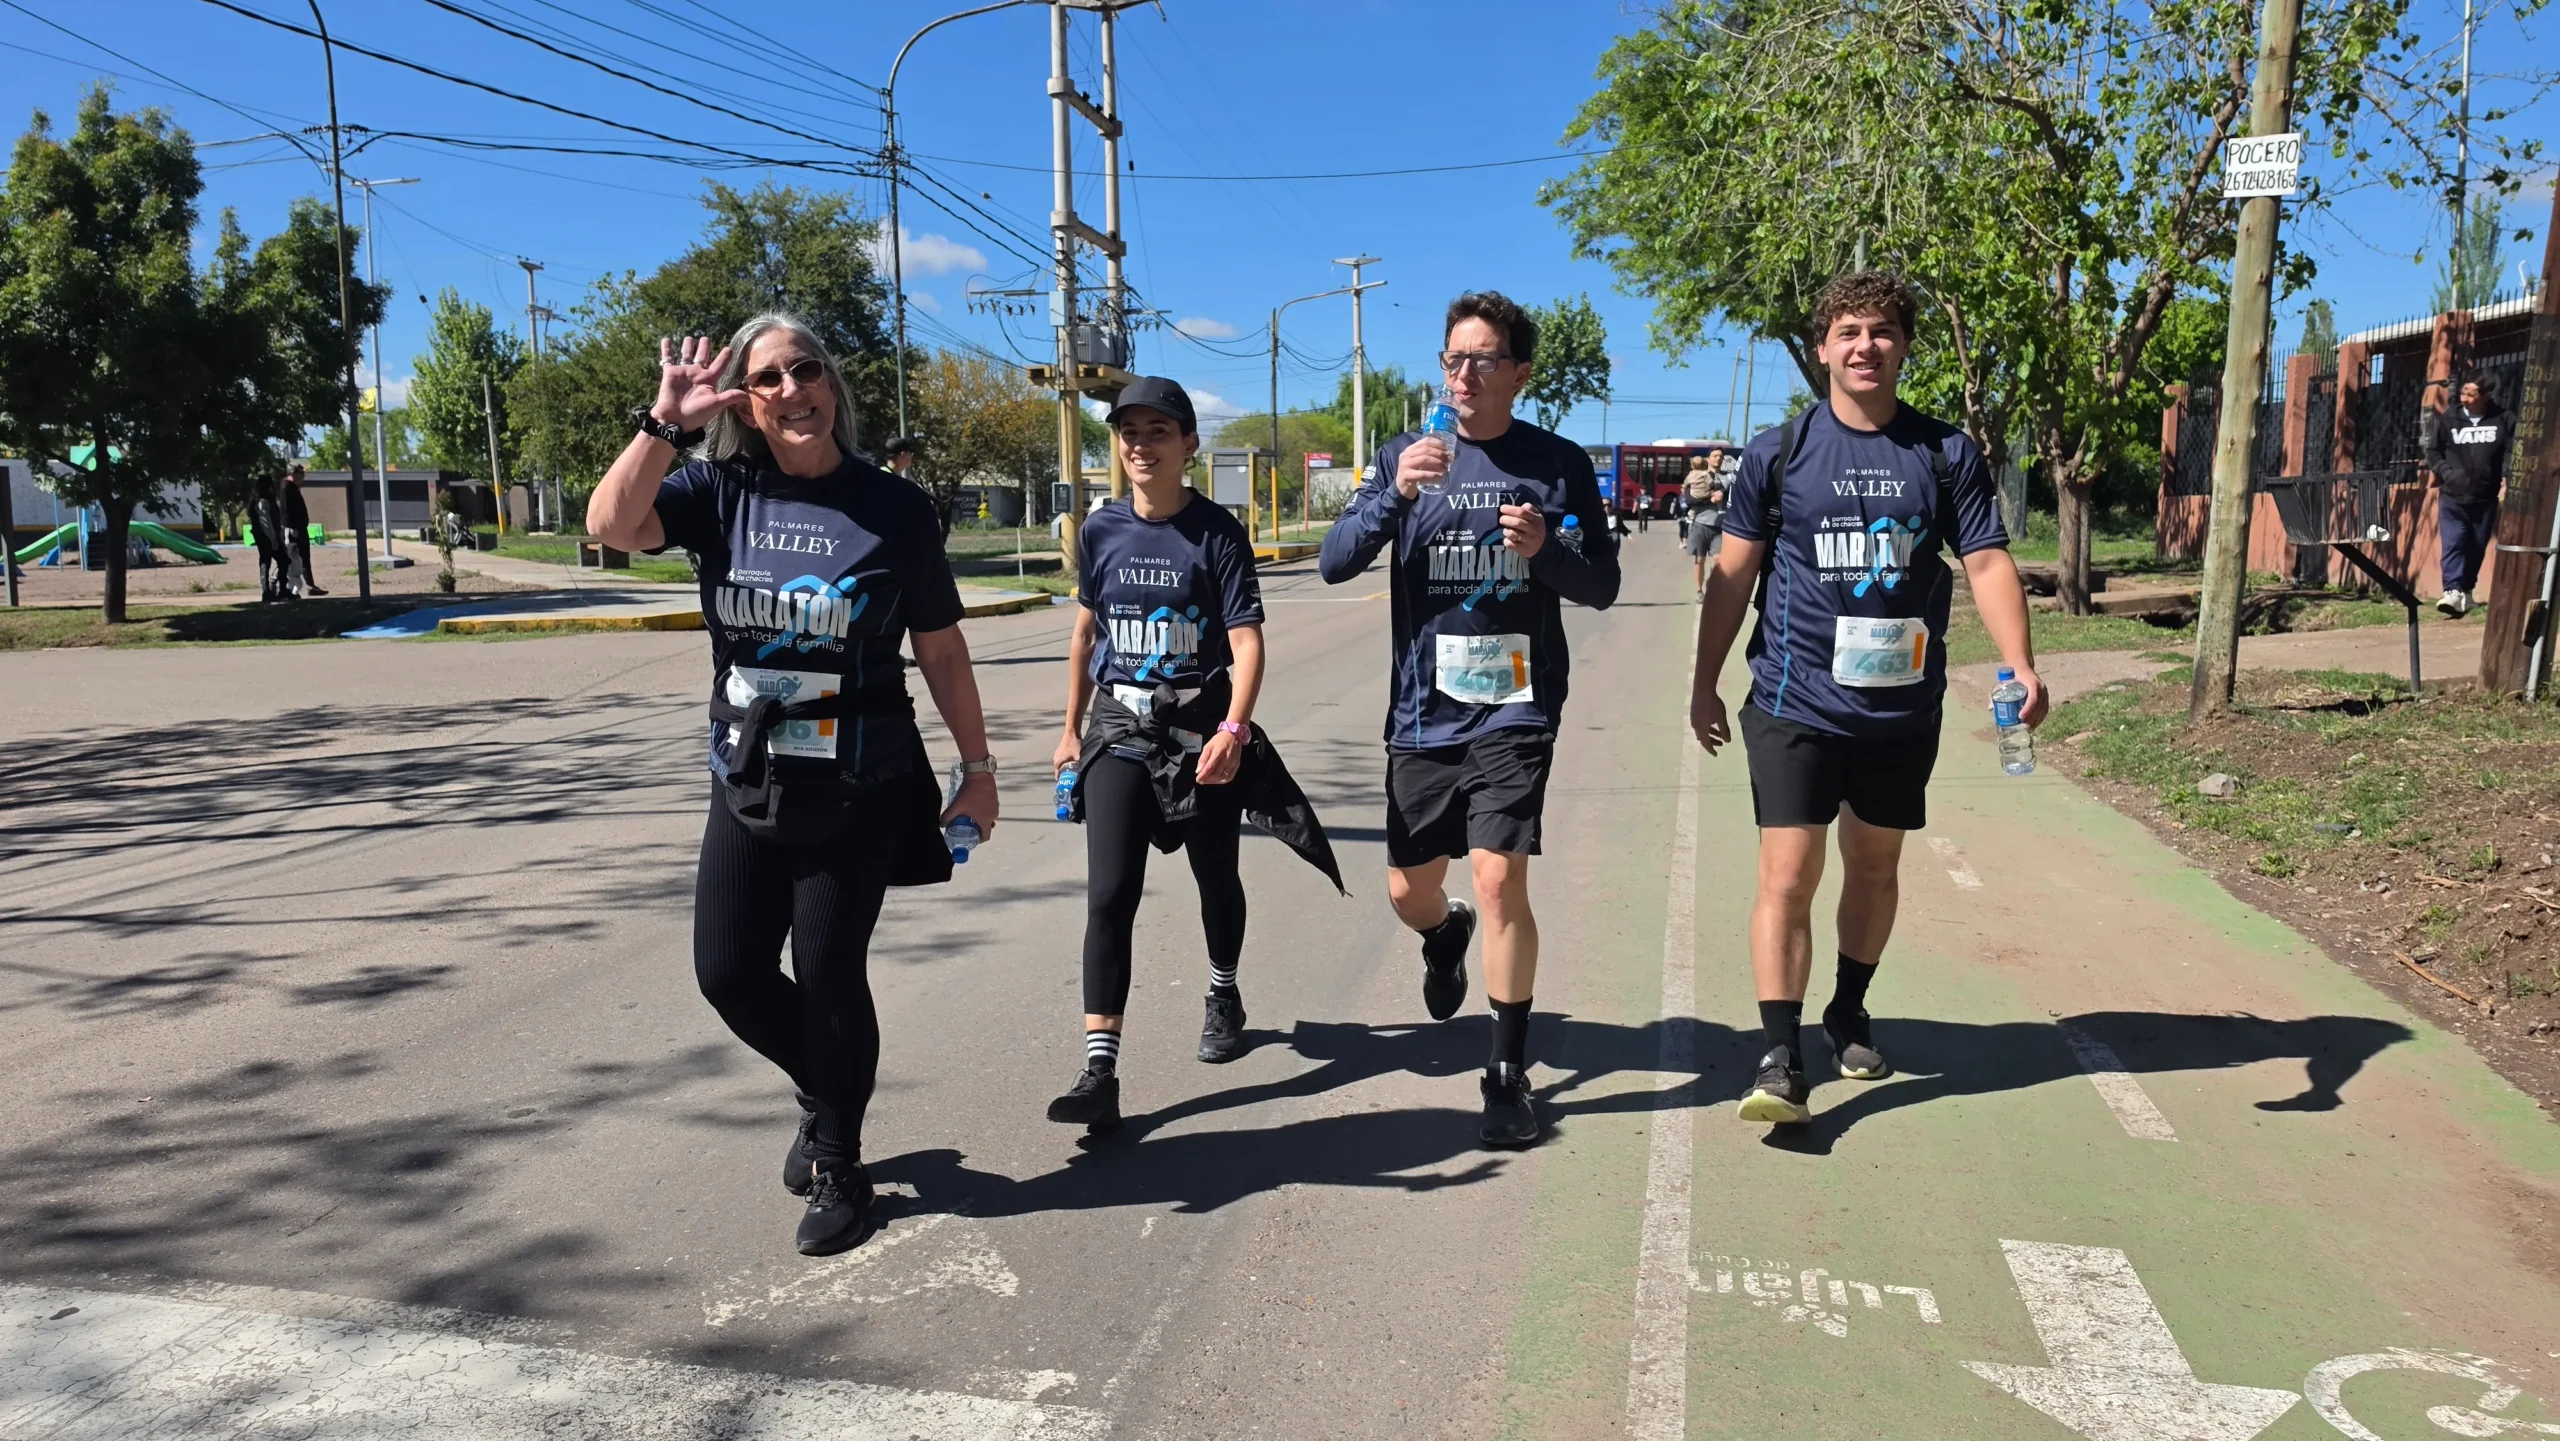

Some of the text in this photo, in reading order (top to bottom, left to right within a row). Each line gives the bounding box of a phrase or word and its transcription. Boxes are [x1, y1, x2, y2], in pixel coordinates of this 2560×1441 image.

[2228, 140, 2299, 166] POCERO
[2451, 426, 2498, 444] VANS
[1461, 481, 1507, 489] PALMARES
[1831, 480, 1906, 497] VALLEY
[768, 521, 824, 532] PALMARES
[749, 531, 841, 556] VALLEY
[1130, 557, 1171, 565] PALMARES
[737, 569, 771, 577] parroquia
[1118, 568, 1184, 588] VALLEY
[1820, 572, 1840, 583] para
[1843, 570, 1869, 581] toda
[1428, 583, 1529, 596] para toda la familia
[716, 585, 852, 638] MARATÓN
[751, 629, 779, 644] toda
[782, 635, 792, 648] la
[796, 638, 845, 653] familia
[1126, 657, 1146, 667] toda
[1150, 658, 1159, 668] la
[1160, 658, 1198, 668] familia
[1855, 652, 1909, 674] 463
[1455, 669, 1513, 691] 408
